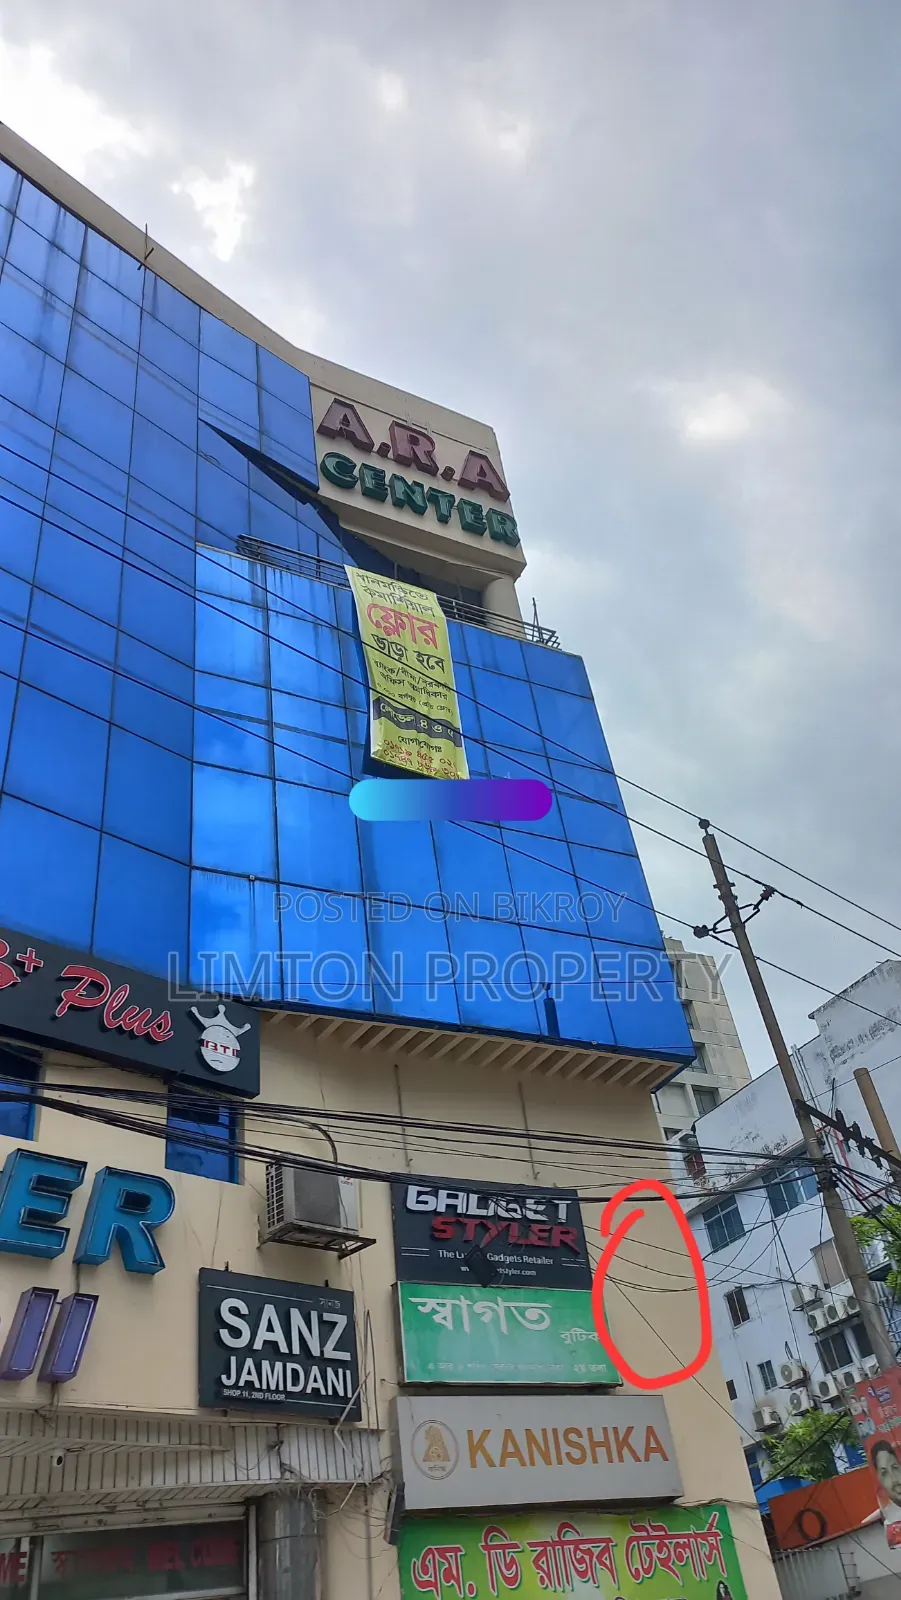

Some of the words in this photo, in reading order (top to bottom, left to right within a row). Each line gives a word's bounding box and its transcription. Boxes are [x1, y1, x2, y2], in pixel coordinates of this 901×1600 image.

[316, 397, 510, 502] A.R.A
[320, 451, 520, 547] CENTER
[367, 603, 439, 650] ফ্লোর
[371, 633, 408, 662] ভাড়া
[413, 650, 446, 675] হবে
[55, 964, 174, 1043] Plus
[431, 1215, 581, 1255] STYLER
[438, 1249, 455, 1259] The
[486, 1252, 522, 1264] Gadgets
[523, 1255, 554, 1265] Retailer
[219, 1297, 351, 1361] SANZ
[408, 1295, 552, 1335] স্বাগত
[221, 1355, 353, 1398] JAMDANI
[223, 1388, 241, 1397] SHOP
[265, 1393, 286, 1401] FLOOR
[466, 1425, 669, 1469] KANISHKA
[480, 1524, 524, 1596] ডি
[525, 1521, 620, 1590] রাজিব
[624, 1511, 728, 1586] টেইলার্স
